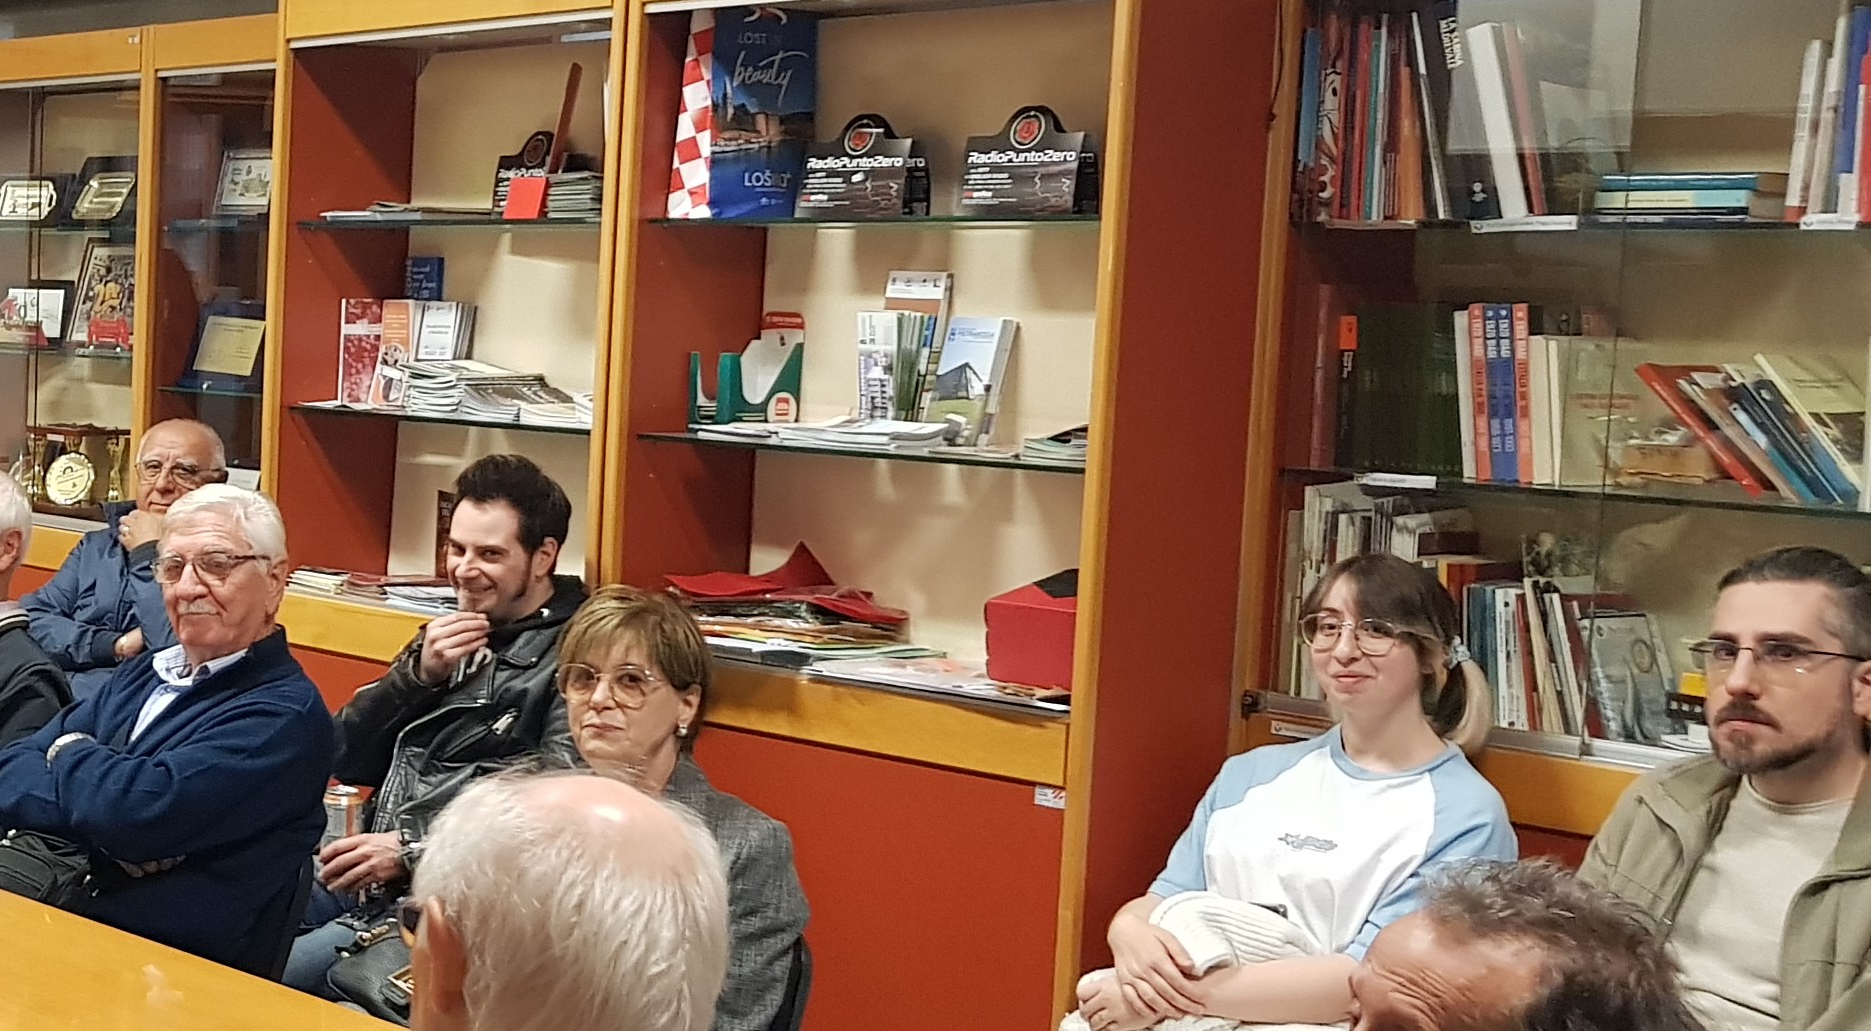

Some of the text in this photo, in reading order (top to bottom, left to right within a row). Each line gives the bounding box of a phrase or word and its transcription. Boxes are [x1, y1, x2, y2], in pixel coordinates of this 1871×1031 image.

[738, 32, 767, 44] LOST
[733, 50, 809, 108] beauty
[806, 156, 903, 169] RadioPuntoZero
[967, 149, 1077, 164] RadioPuntoZero
